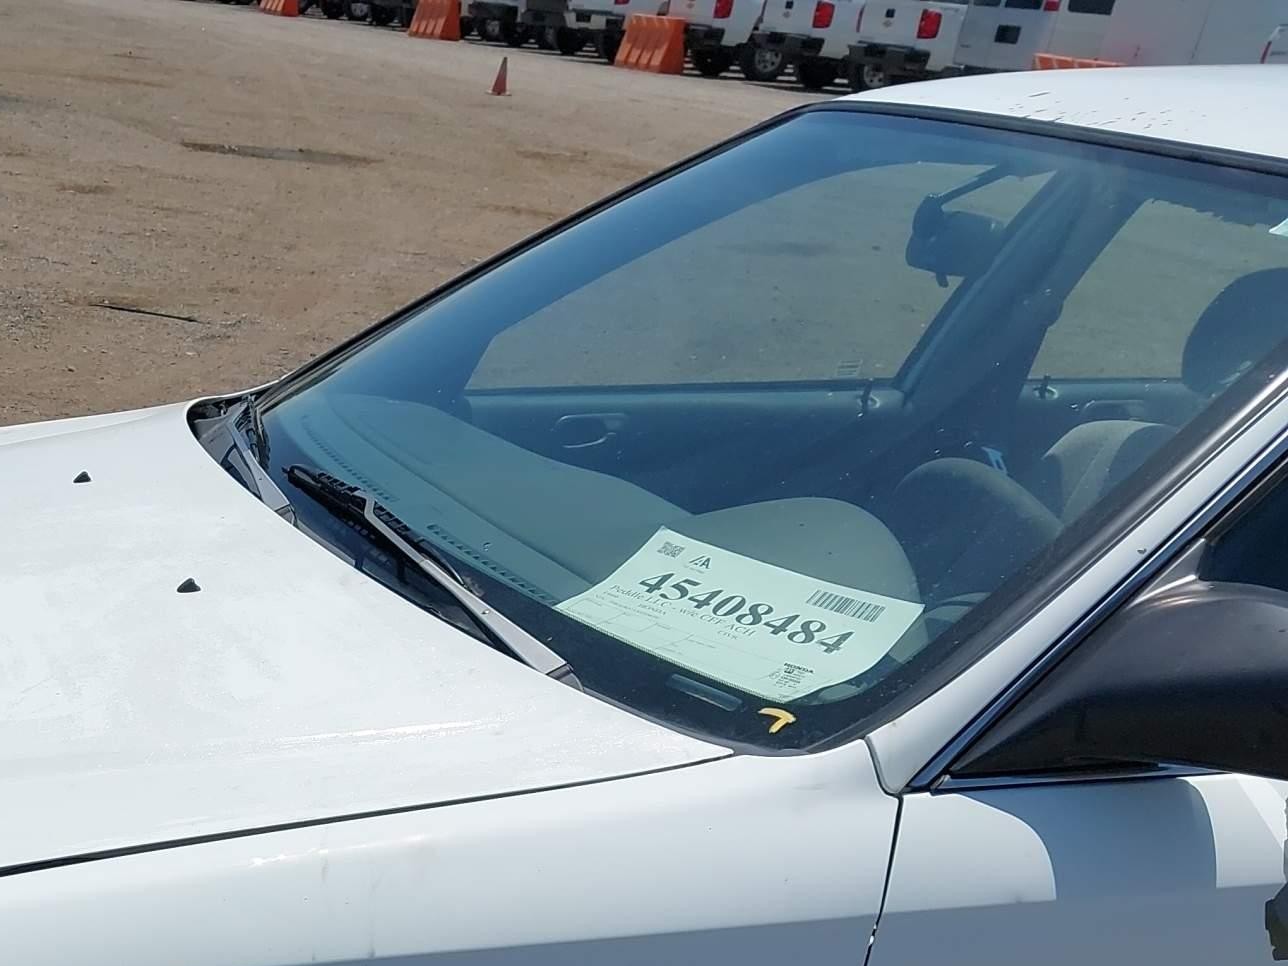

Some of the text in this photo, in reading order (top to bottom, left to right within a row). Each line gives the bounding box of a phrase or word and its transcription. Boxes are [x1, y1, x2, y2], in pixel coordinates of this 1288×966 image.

[610, 584, 645, 600] Peddle
[638, 572, 855, 654] 45408484
[783, 662, 814, 674] HONDA
